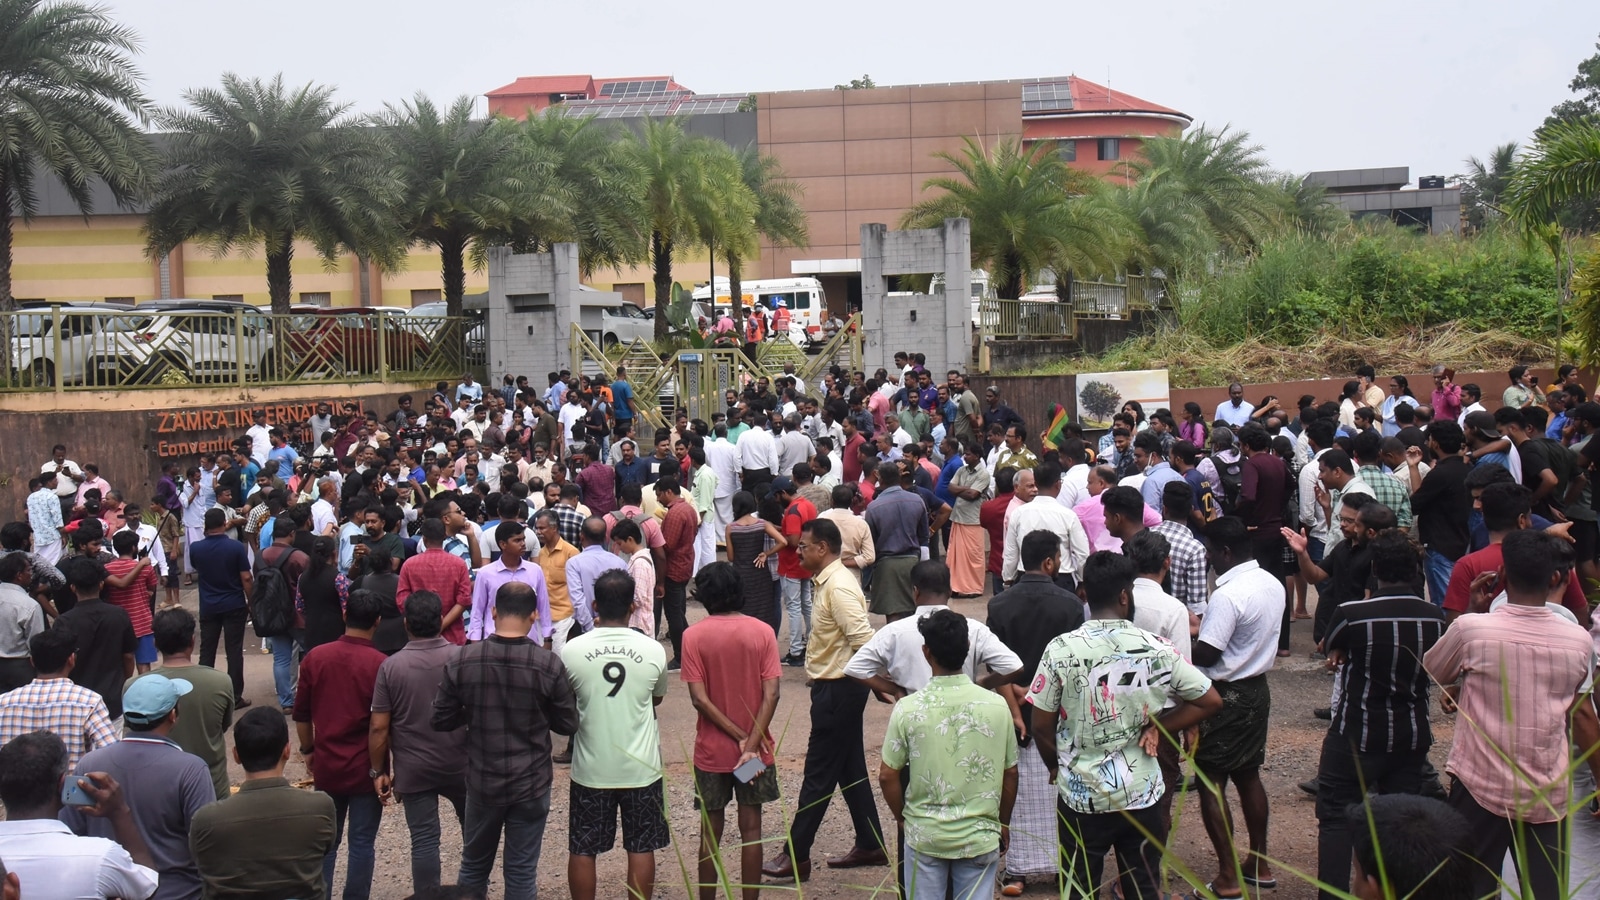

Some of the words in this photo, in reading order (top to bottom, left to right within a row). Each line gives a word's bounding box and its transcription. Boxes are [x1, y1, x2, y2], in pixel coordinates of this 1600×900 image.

[157, 410, 229, 432] ZAMRA
[234, 399, 366, 427] INERNATNL
[158, 436, 236, 457] Conventi
[585, 645, 643, 664] HAALAND
[602, 661, 626, 697] 9
